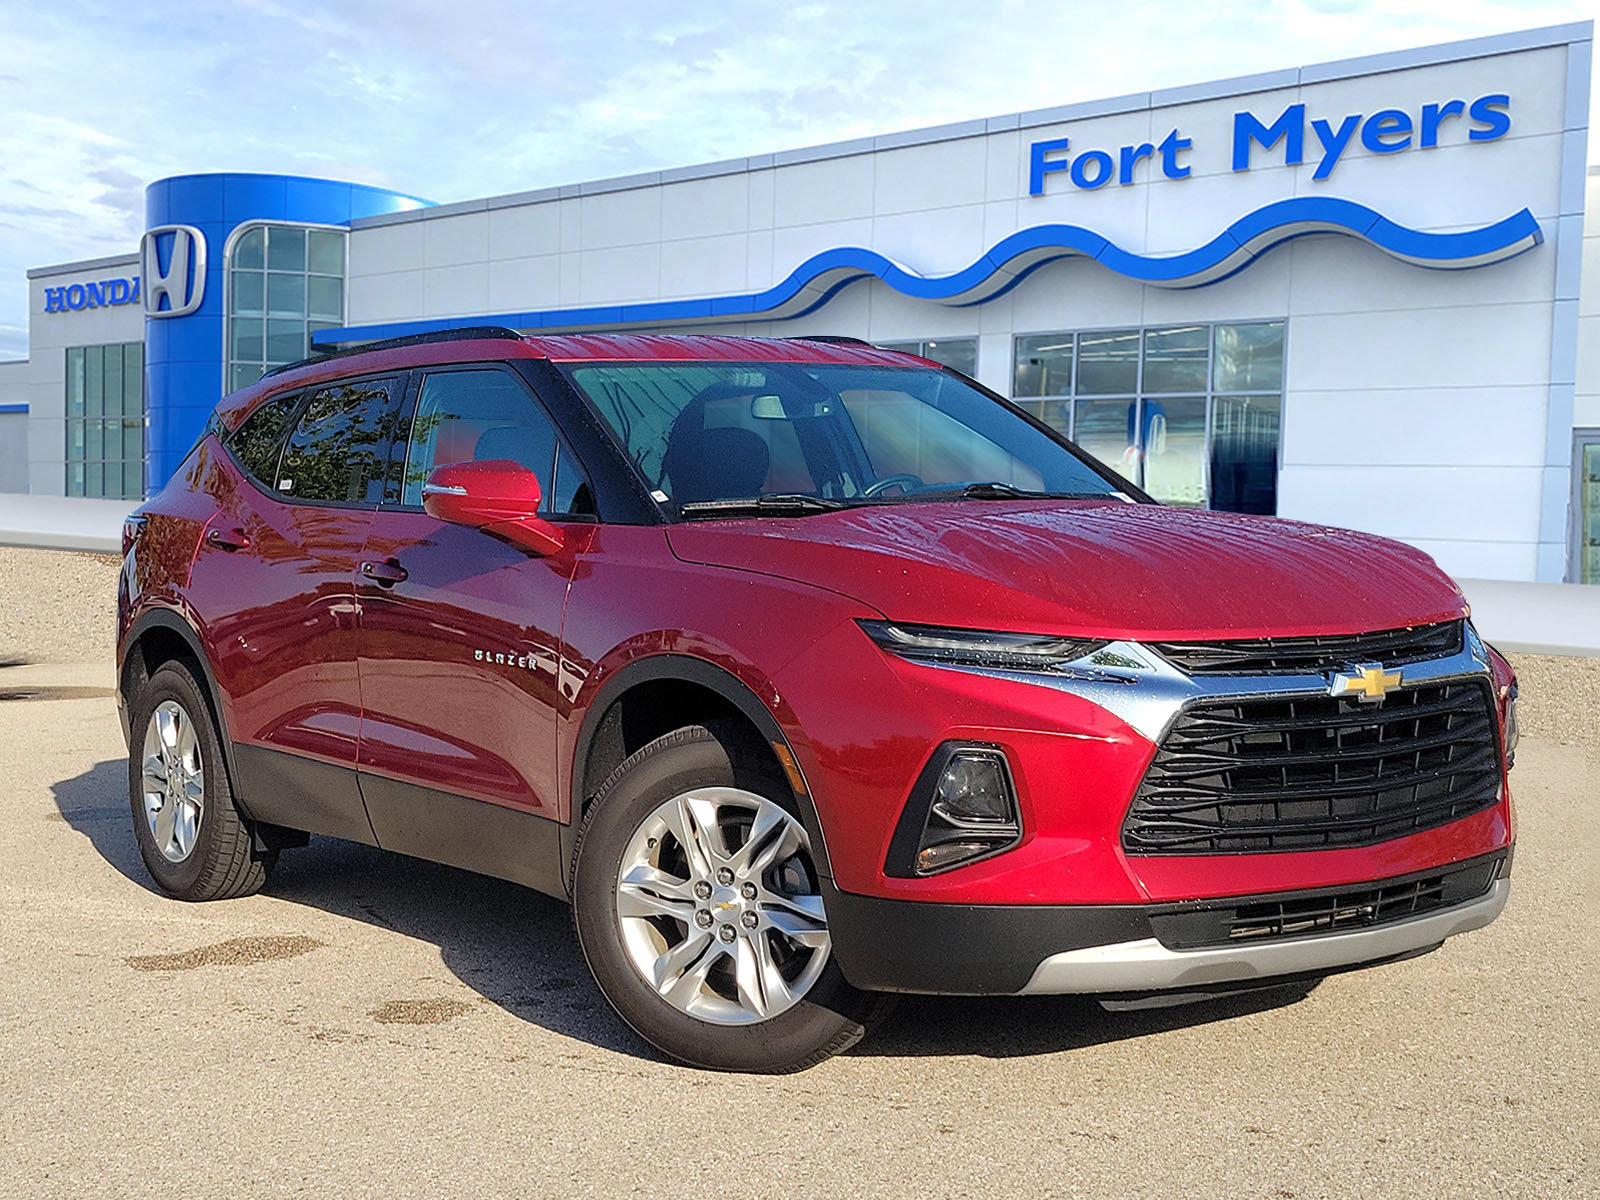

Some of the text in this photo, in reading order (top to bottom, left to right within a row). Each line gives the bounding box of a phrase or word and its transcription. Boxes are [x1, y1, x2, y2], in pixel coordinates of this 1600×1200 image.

[1029, 93, 1511, 197] Fort Myers
[474, 649, 537, 671] BLAZER
